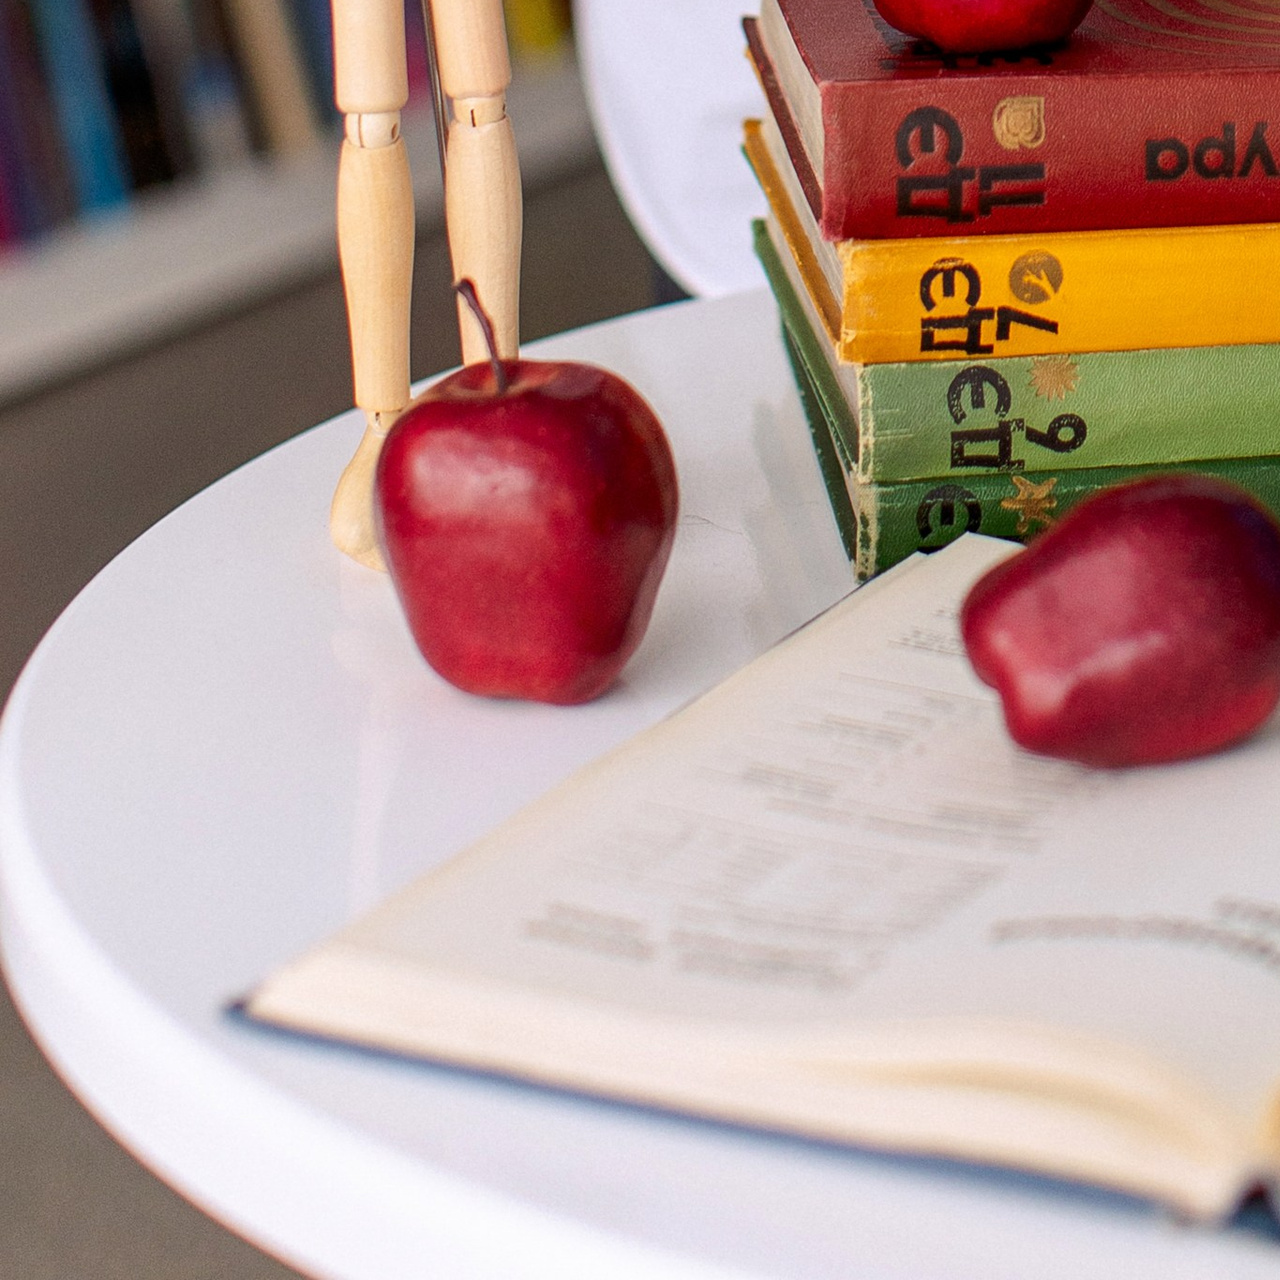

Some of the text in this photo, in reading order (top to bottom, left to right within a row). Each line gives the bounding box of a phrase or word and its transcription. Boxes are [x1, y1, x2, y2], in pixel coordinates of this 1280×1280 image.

[895, 105, 976, 224] ДЭ
[978, 162, 1046, 218] 11
[920, 256, 997, 356] ДЭ
[996, 305, 1059, 341] 7
[947, 365, 1026, 473] ДЭ
[1026, 413, 1088, 454] 6
